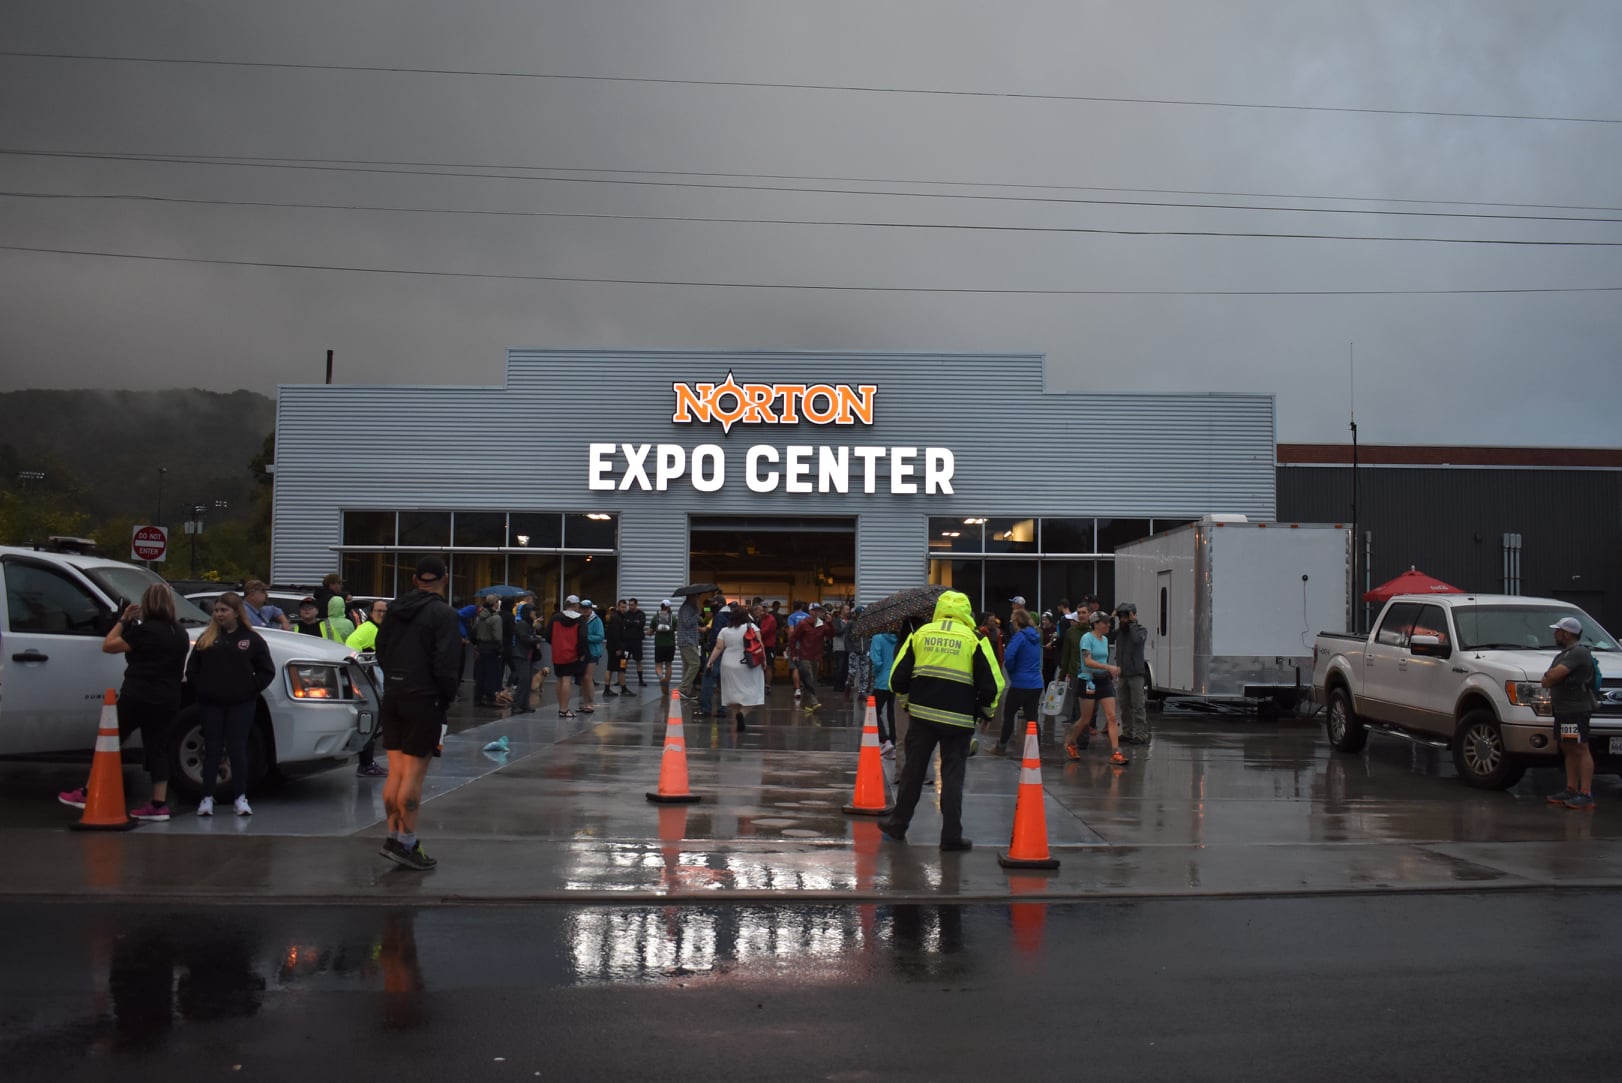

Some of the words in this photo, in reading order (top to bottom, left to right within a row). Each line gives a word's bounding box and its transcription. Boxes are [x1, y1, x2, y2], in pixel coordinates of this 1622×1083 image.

[672, 371, 878, 434] NORTON
[588, 443, 726, 492] EXPO
[745, 444, 955, 495] CENTER
[924, 636, 962, 649] NORTON
